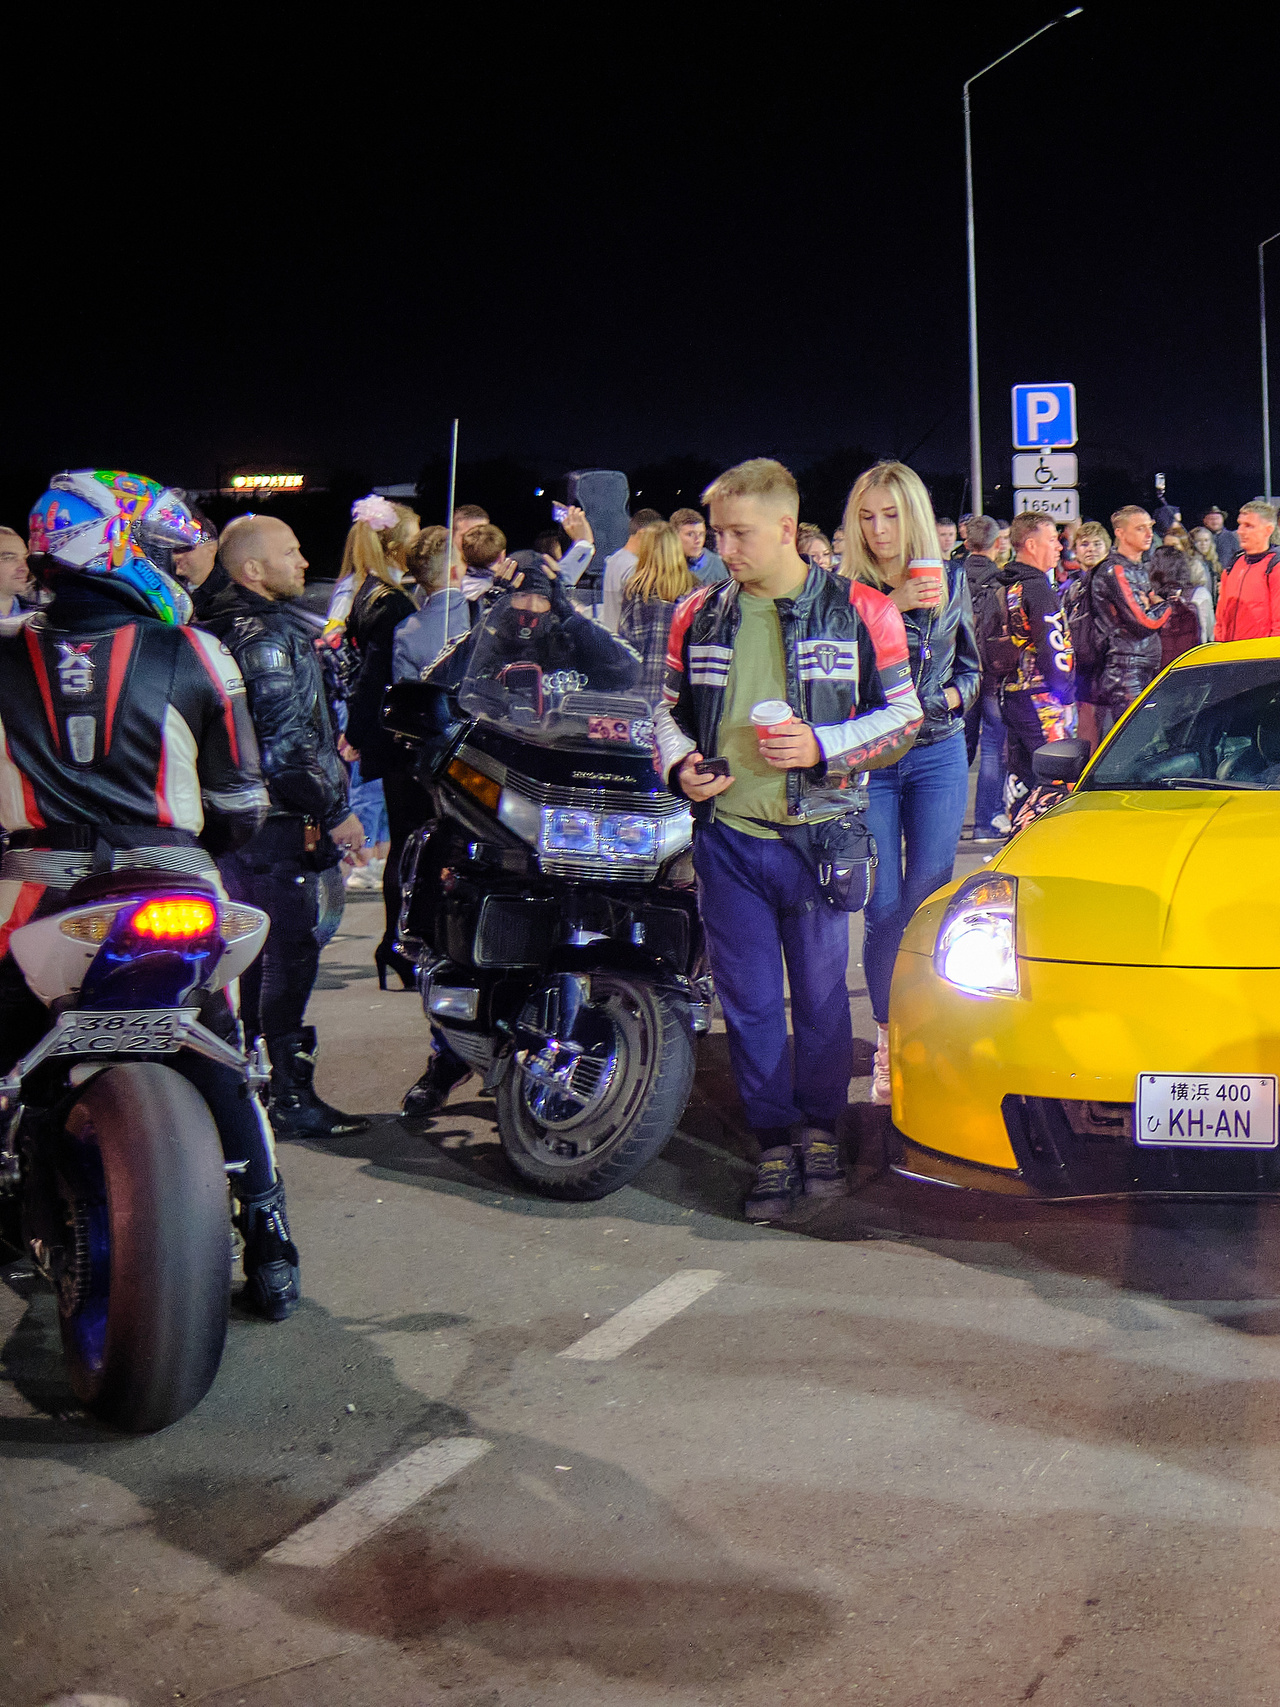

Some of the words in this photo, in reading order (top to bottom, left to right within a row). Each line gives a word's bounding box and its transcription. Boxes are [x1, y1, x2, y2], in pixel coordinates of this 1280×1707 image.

[1027, 391, 1060, 442] P
[78, 1013, 173, 1031] 3844
[126, 1036, 171, 1049] 23
[1171, 1082, 1209, 1101] 横浜
[1215, 1083, 1251, 1101] 400
[1169, 1108, 1250, 1138] KH-AN
